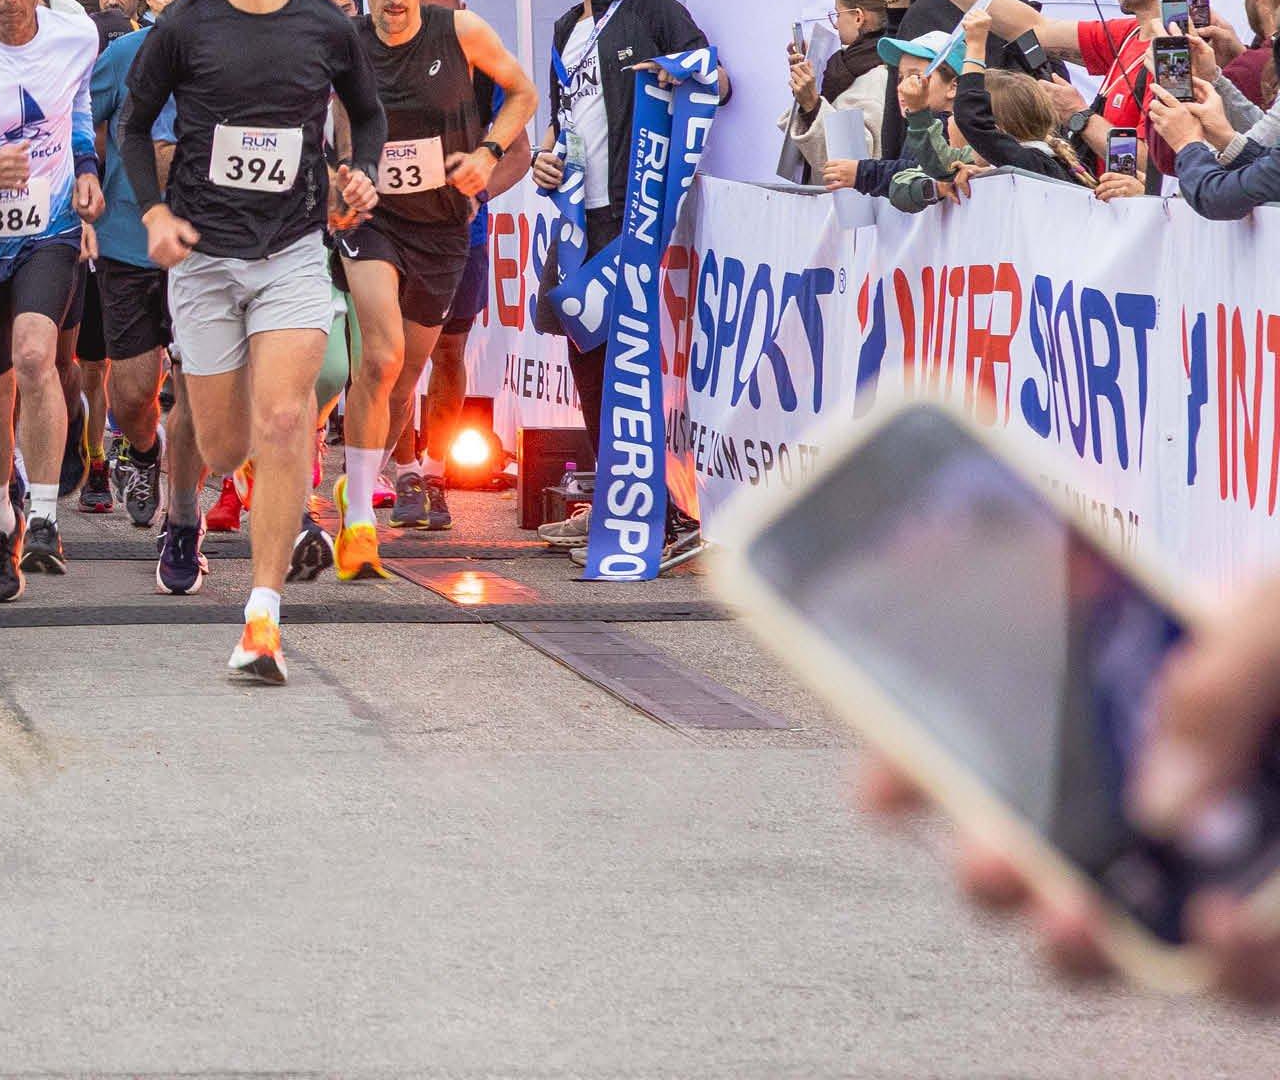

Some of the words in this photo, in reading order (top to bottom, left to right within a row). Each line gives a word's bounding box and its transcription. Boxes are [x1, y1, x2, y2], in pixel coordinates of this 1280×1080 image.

[242, 136, 277, 147] RUN
[386, 148, 417, 158] RUN
[226, 156, 286, 185] 394
[387, 165, 422, 189] 33
[635, 130, 670, 245] RUN
